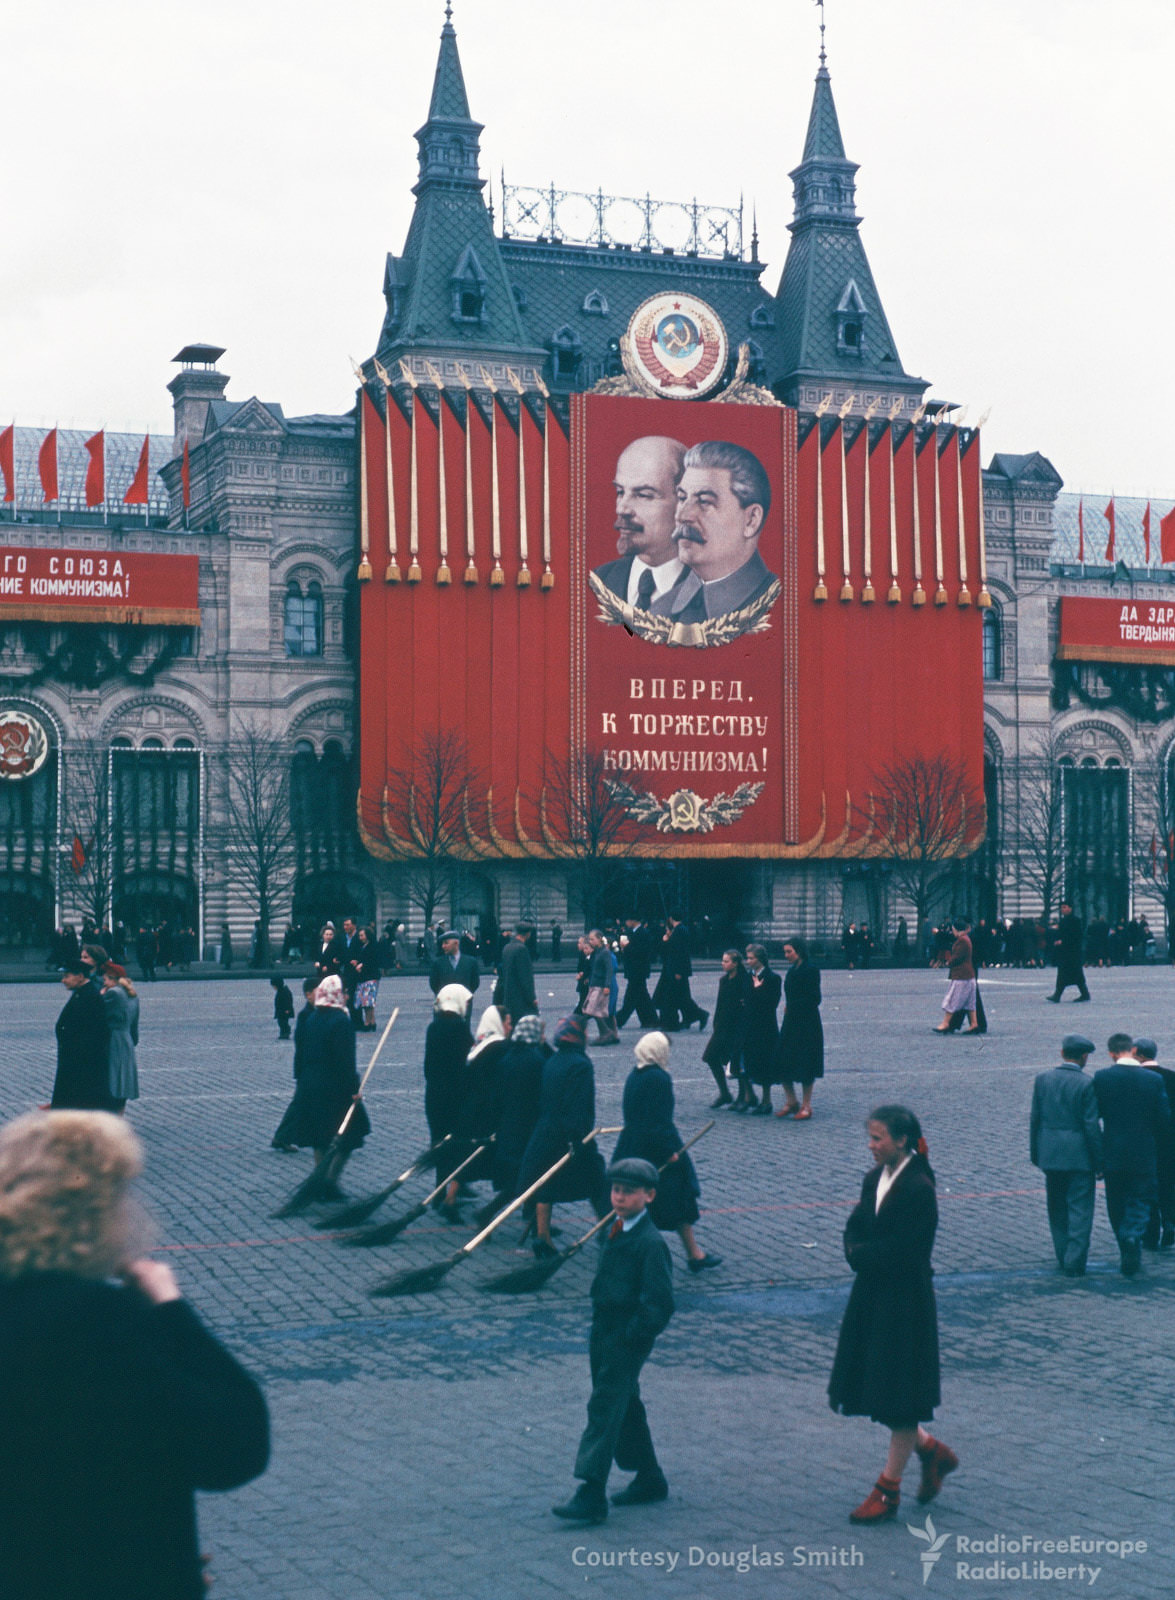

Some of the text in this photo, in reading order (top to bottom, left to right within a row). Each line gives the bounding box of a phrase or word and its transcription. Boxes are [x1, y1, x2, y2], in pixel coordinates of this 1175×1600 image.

[5, 555, 130, 579] ГО СОЮЗА,
[30, 577, 130, 598] КОММУНИЗМА!
[1119, 605, 1175, 624] ДА ЗДР
[1119, 624, 1175, 643] ТВЕРДЫНЯ
[601, 712, 768, 736] К ТОРЖЕСТВУ
[602, 747, 768, 773] КОММУНИЗМА!
